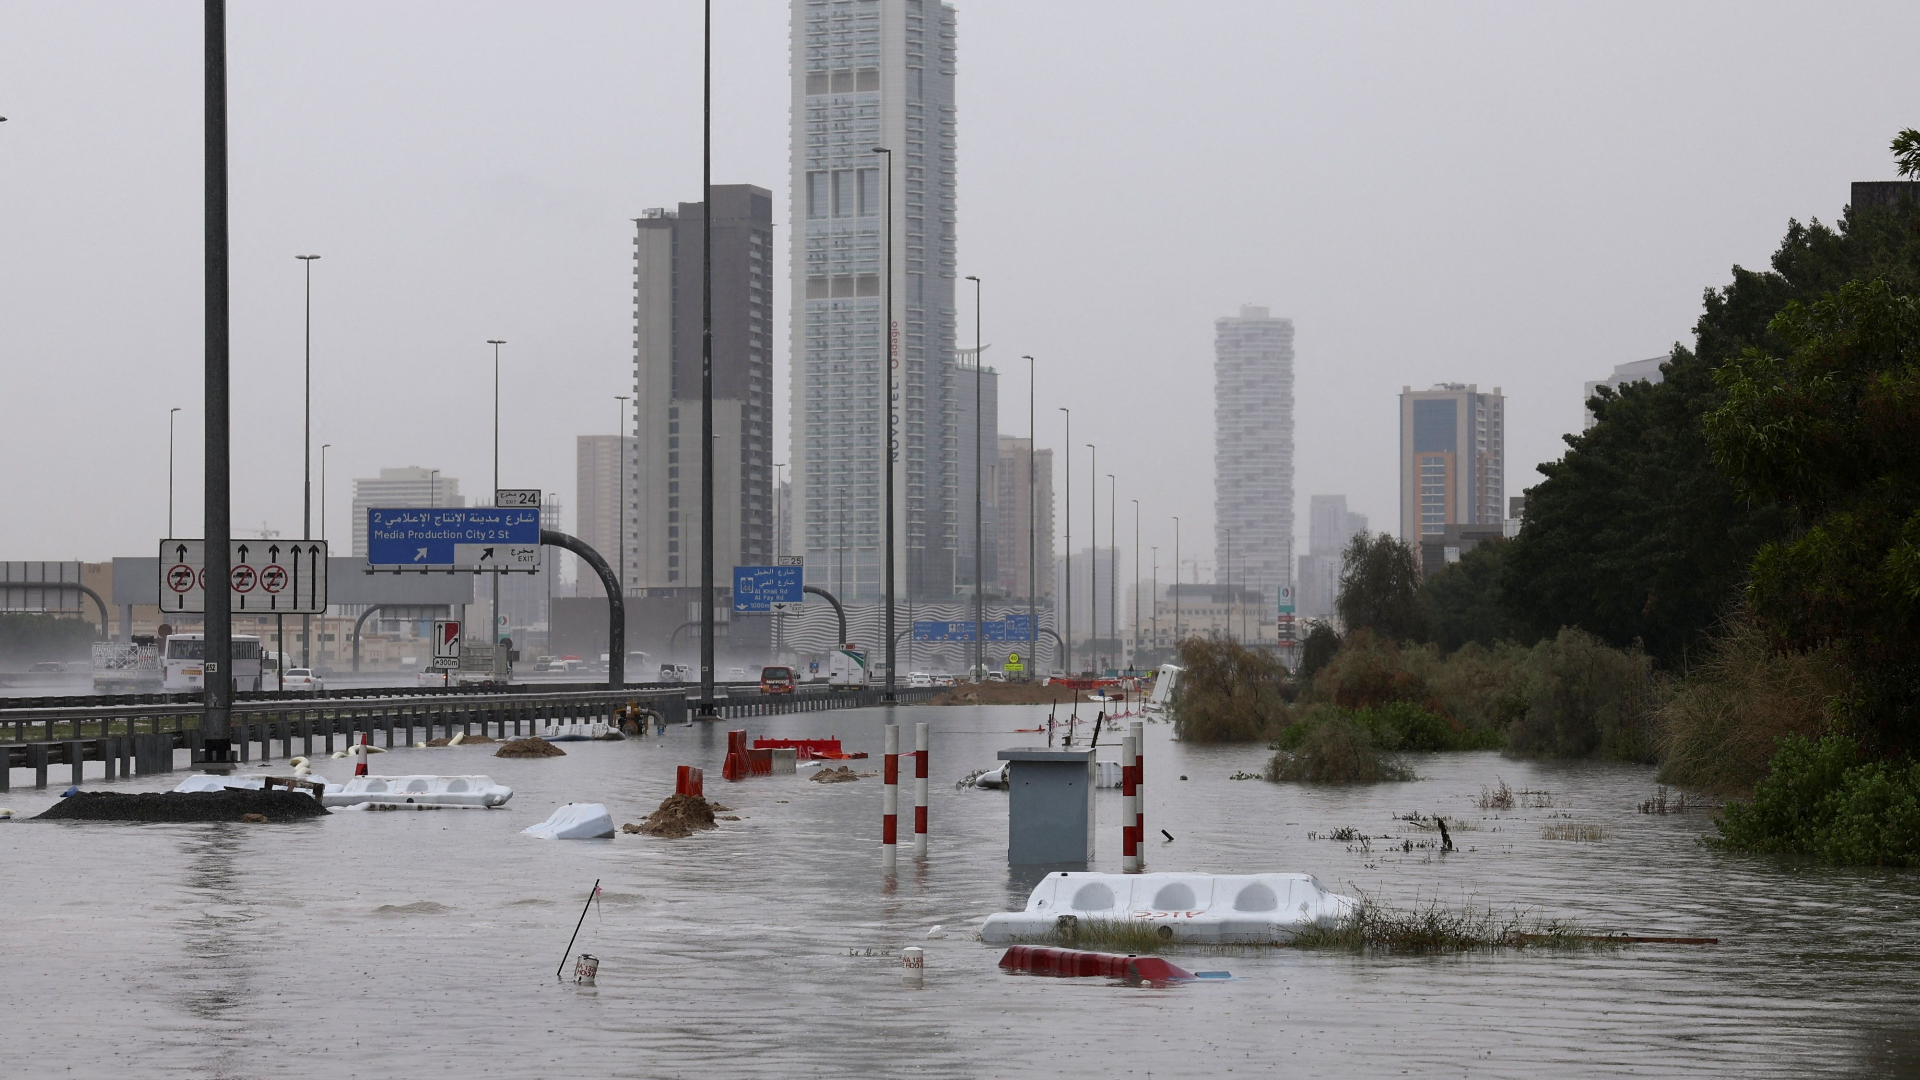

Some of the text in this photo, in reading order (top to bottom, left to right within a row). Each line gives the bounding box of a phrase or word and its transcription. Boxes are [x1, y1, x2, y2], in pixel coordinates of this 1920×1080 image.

[891, 321, 900, 356] adagio
[891, 382, 899, 463] NOVOTEL
[519, 493, 537, 505] 24
[374, 512, 535, 527] شارع مدينة الإنتاج الإعلامي 2
[374, 529, 510, 541] Media Production City 2 St
[510, 547, 535, 556] مخرج
[439, 658, 458, 666] 300m
